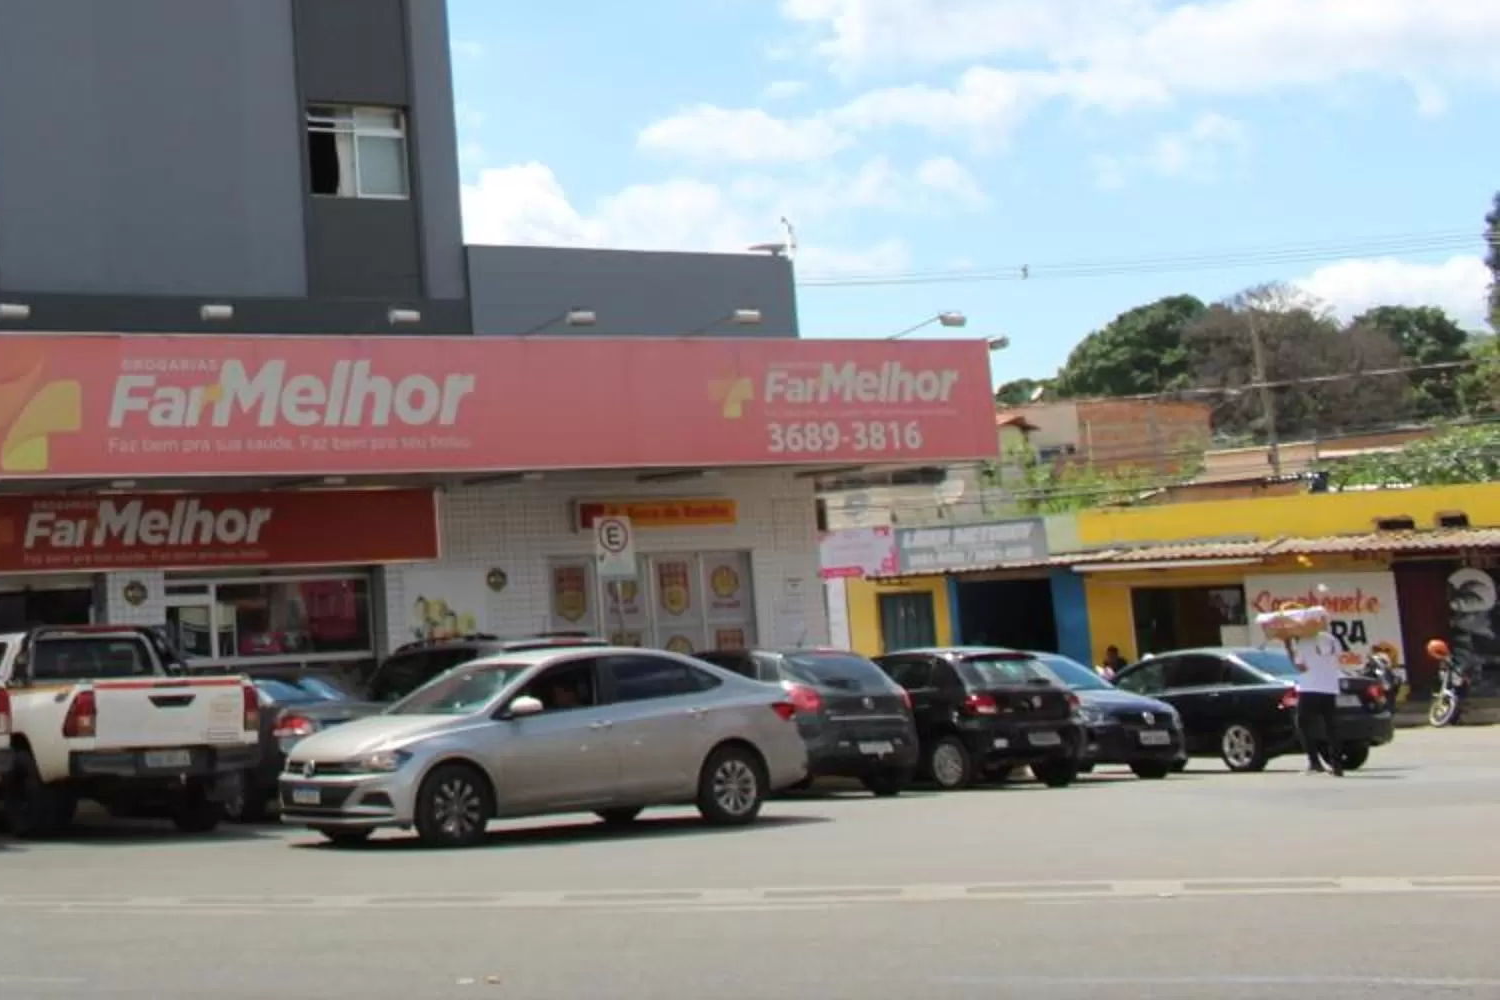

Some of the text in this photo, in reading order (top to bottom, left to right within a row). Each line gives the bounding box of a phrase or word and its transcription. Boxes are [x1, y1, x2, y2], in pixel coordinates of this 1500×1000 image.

[108, 358, 476, 428] FarMelhor
[763, 360, 960, 403] FarMelhor
[766, 420, 923, 452] 3689-3816
[23, 498, 273, 549] FarMelhor
[606, 526, 621, 546] E
